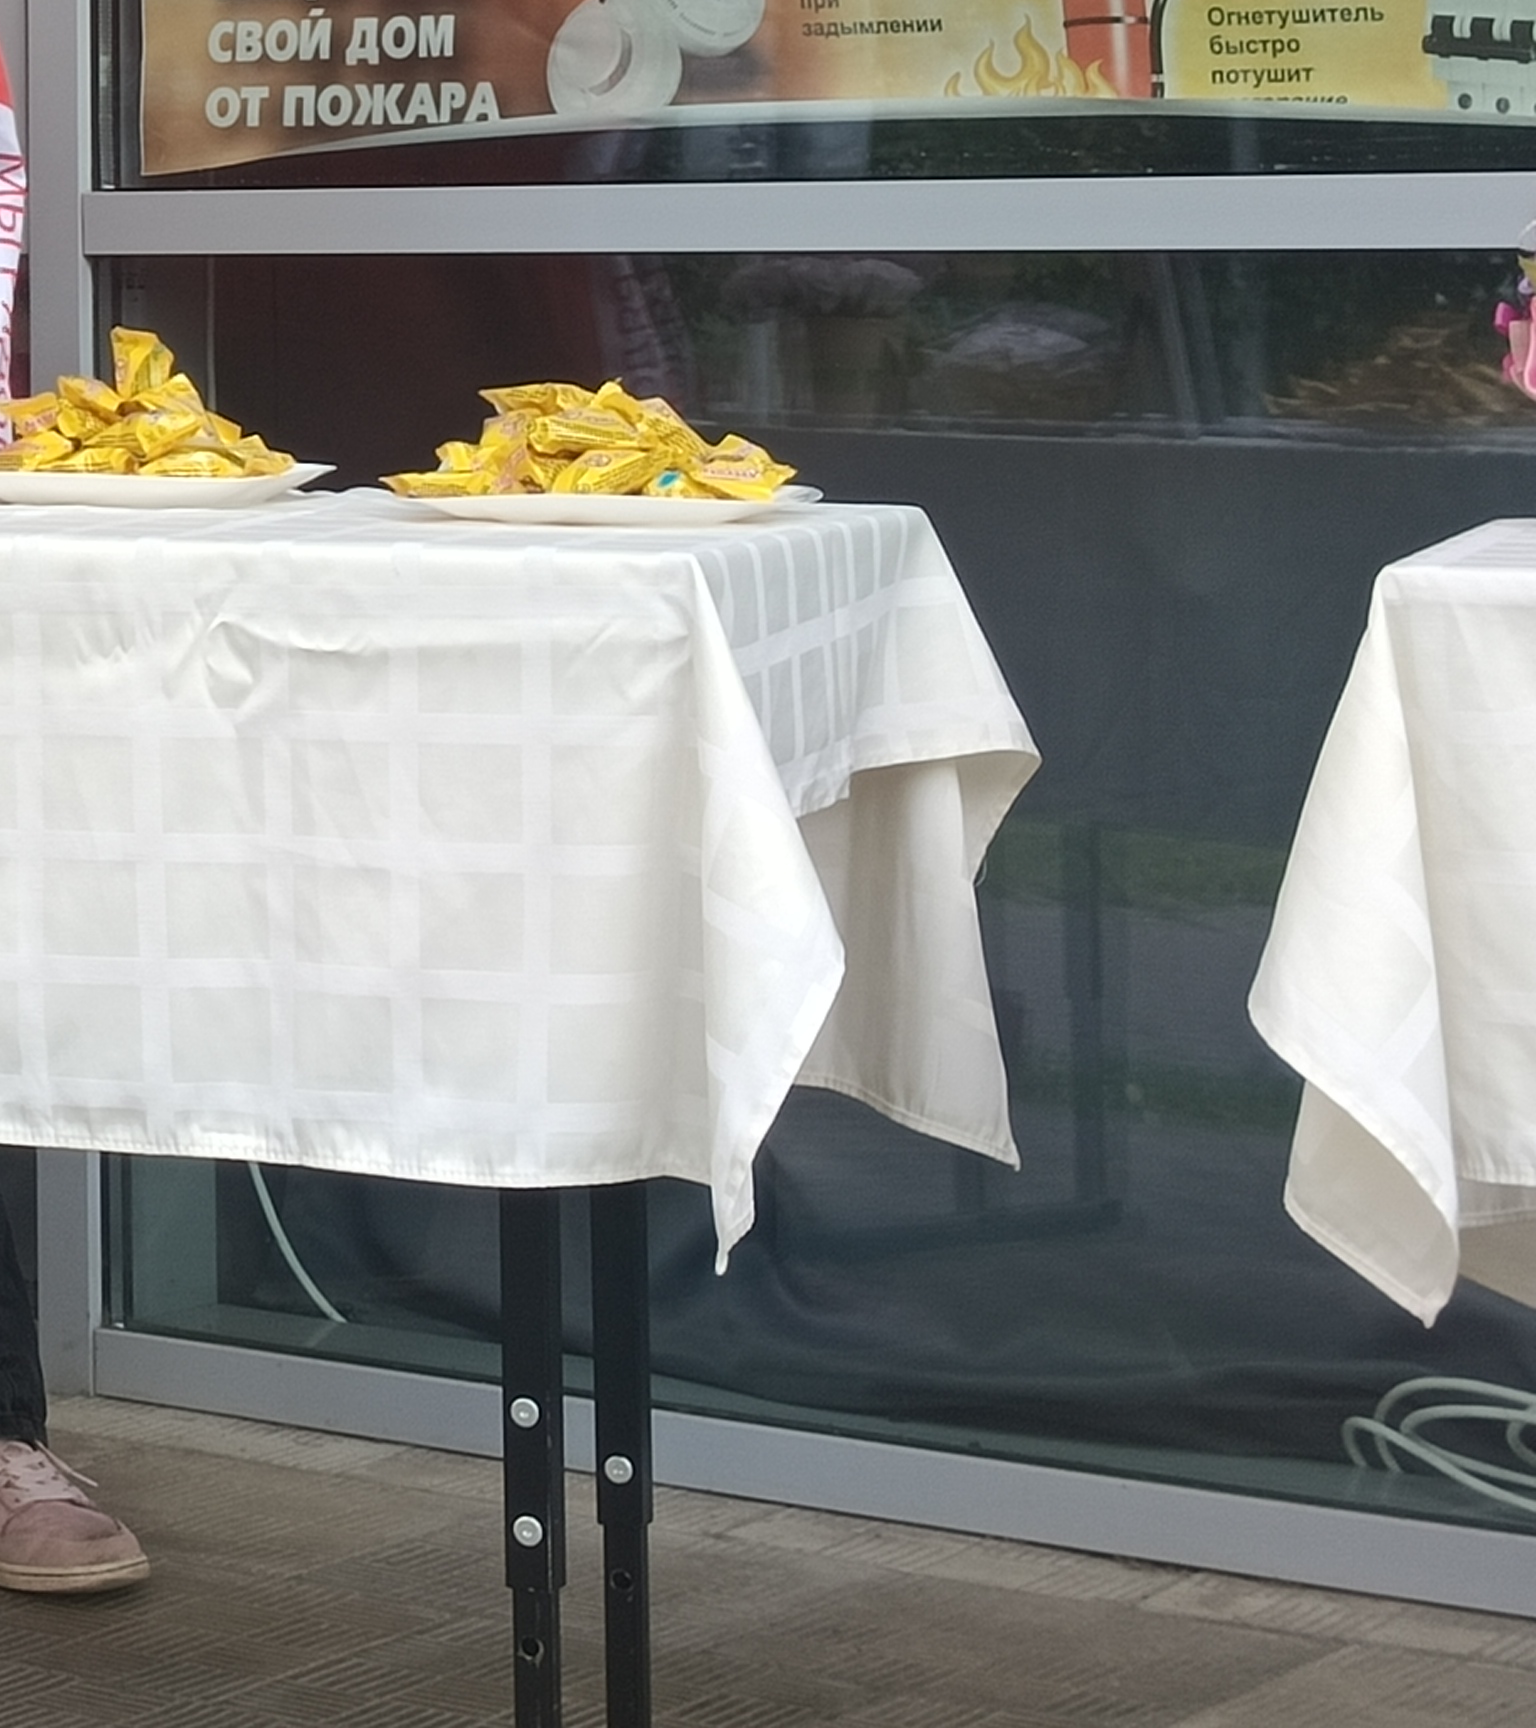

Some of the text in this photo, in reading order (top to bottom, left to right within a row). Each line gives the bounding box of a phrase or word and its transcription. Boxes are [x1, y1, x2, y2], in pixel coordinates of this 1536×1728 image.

[802, 15, 944, 38] задымлении
[1207, 5, 1385, 29] Огнетушитель
[207, 5, 455, 67] СВОЙ ДОМ
[1209, 34, 1301, 59] быстро
[1211, 64, 1314, 87] потушит
[205, 77, 502, 127] ОТ ПОЖАРА
